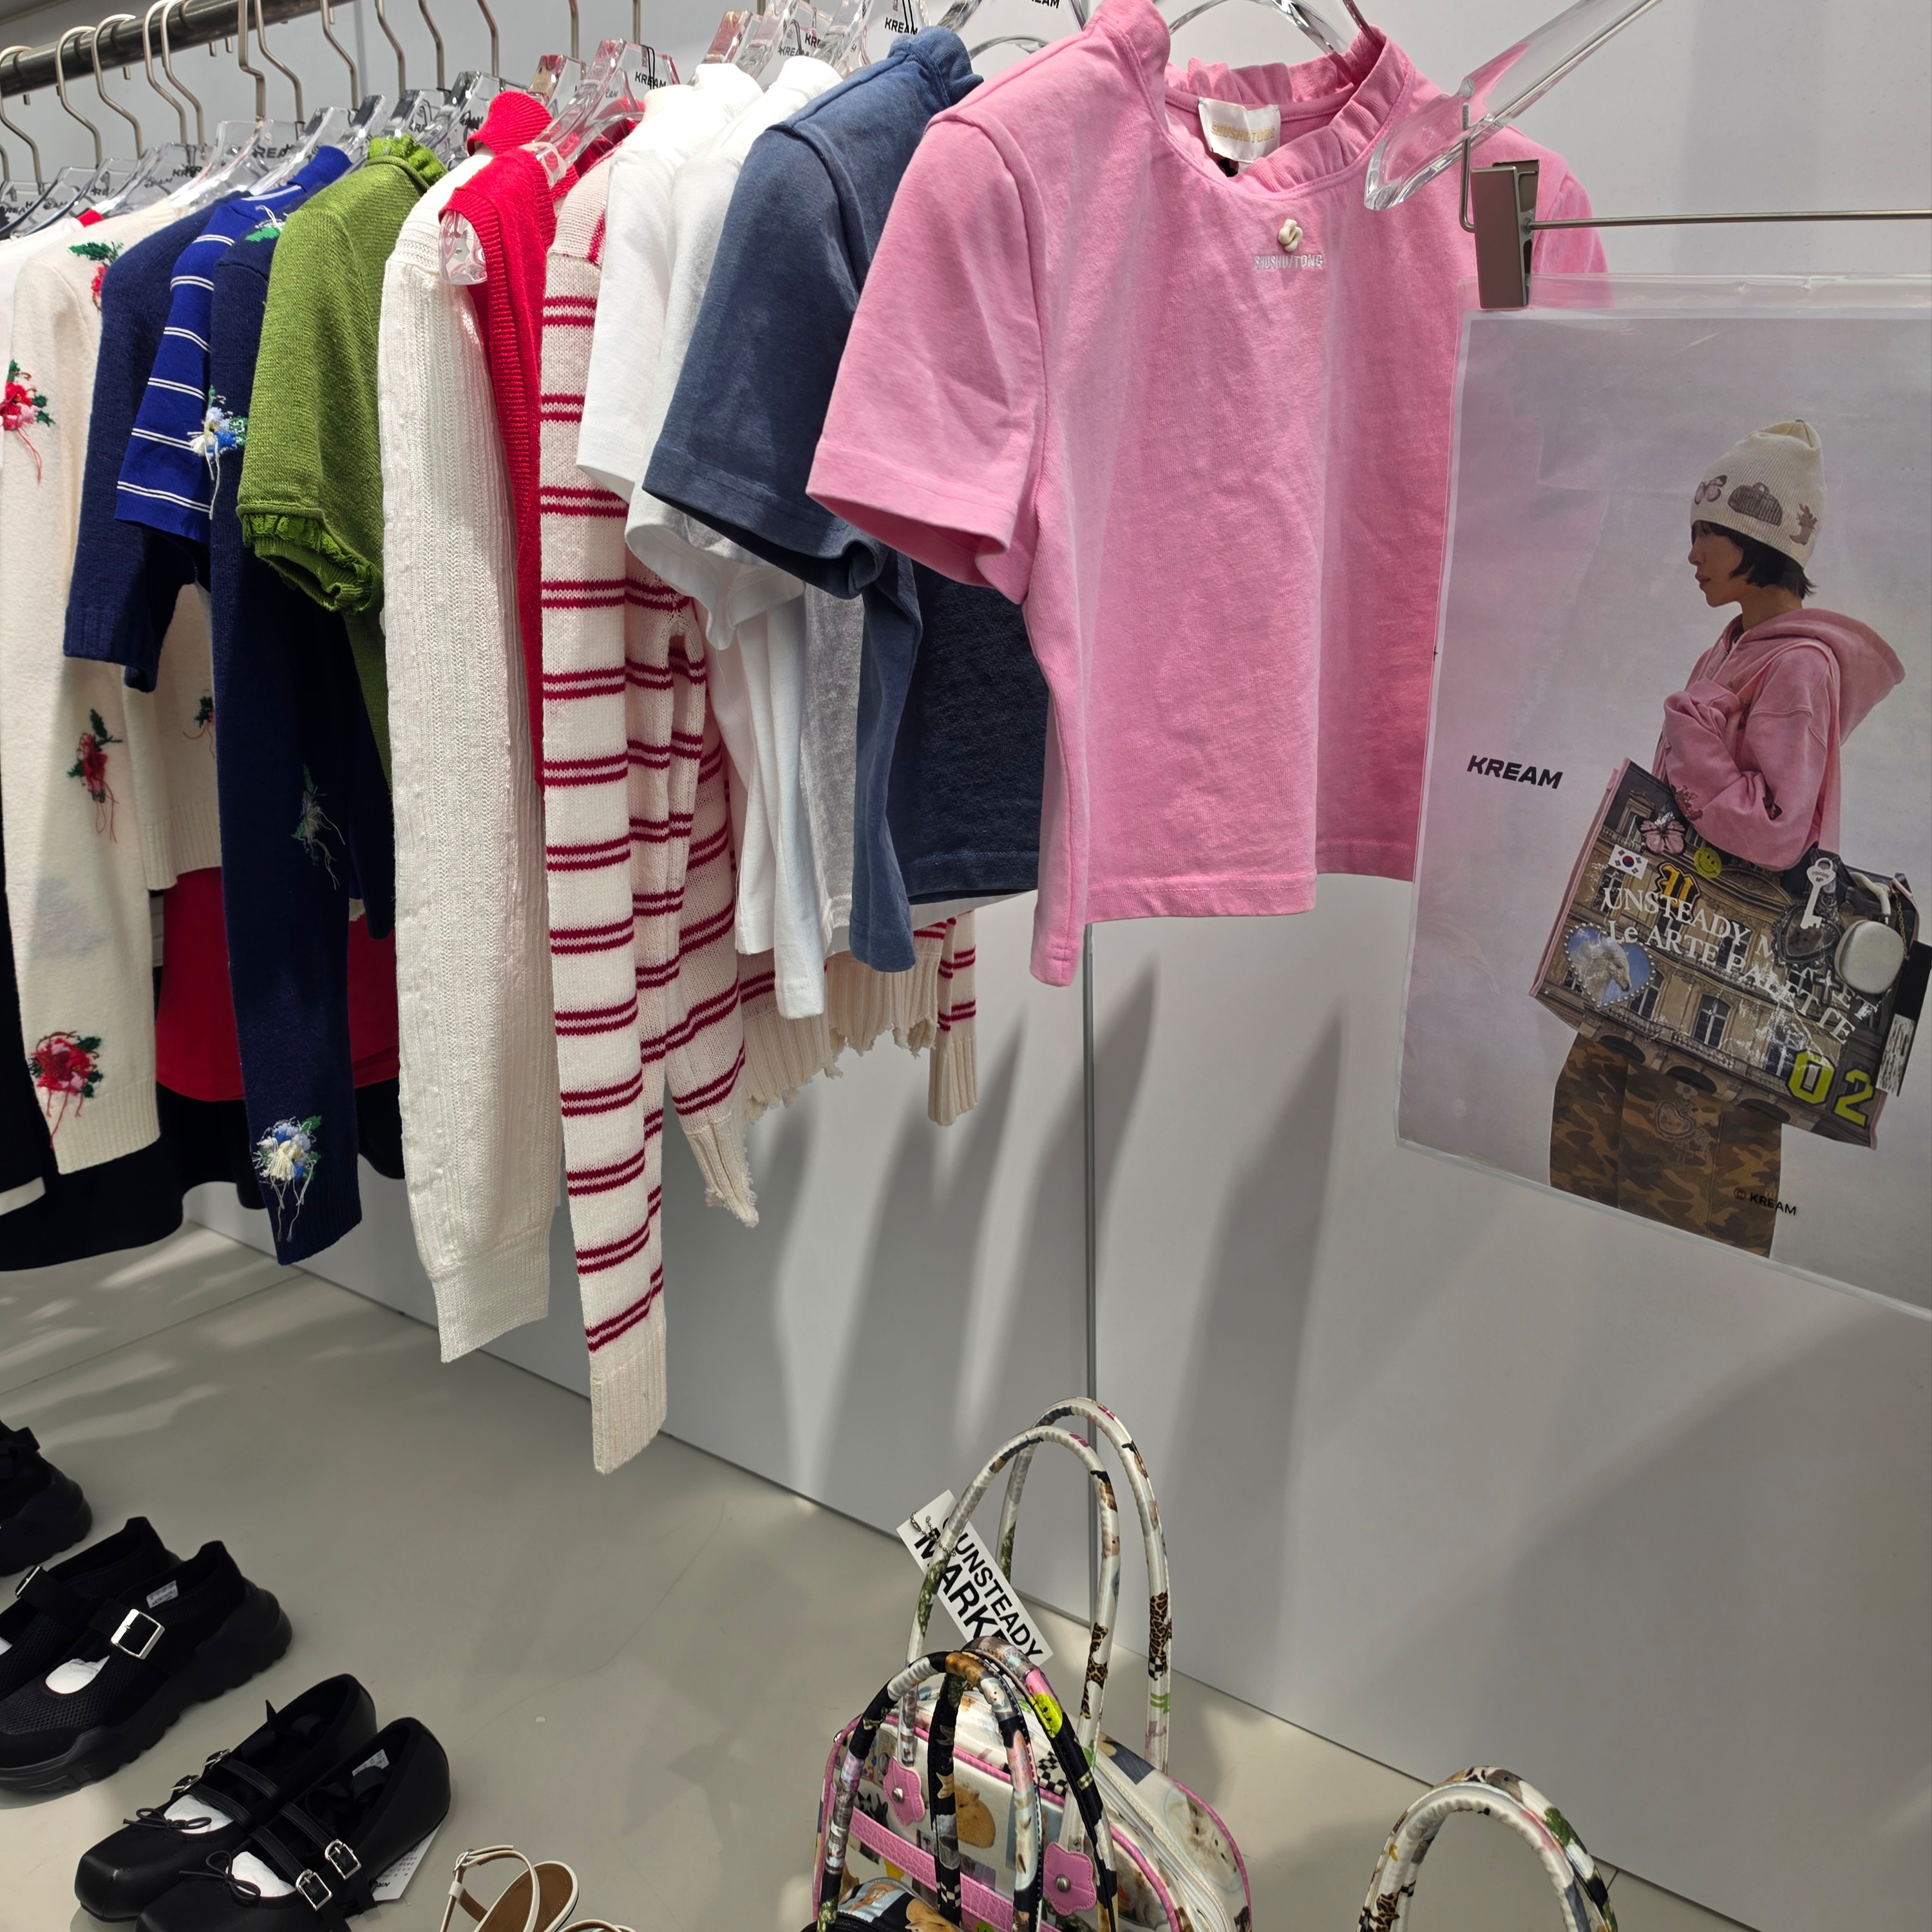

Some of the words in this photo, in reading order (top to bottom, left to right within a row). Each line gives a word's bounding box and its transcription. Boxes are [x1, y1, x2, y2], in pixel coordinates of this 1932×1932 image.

[884, 17, 918, 35] KREAM
[1254, 255, 1323, 270] SHUSHU/TONG
[1466, 755, 1564, 790] KREAM
[1602, 887, 1752, 946] UNSTEADY
[1607, 920, 1638, 944] Le
[1645, 925, 1720, 967] ARTE
[1750, 1193, 1797, 1216] KREAM
[954, 1532, 1044, 1658] UNSTEADY
